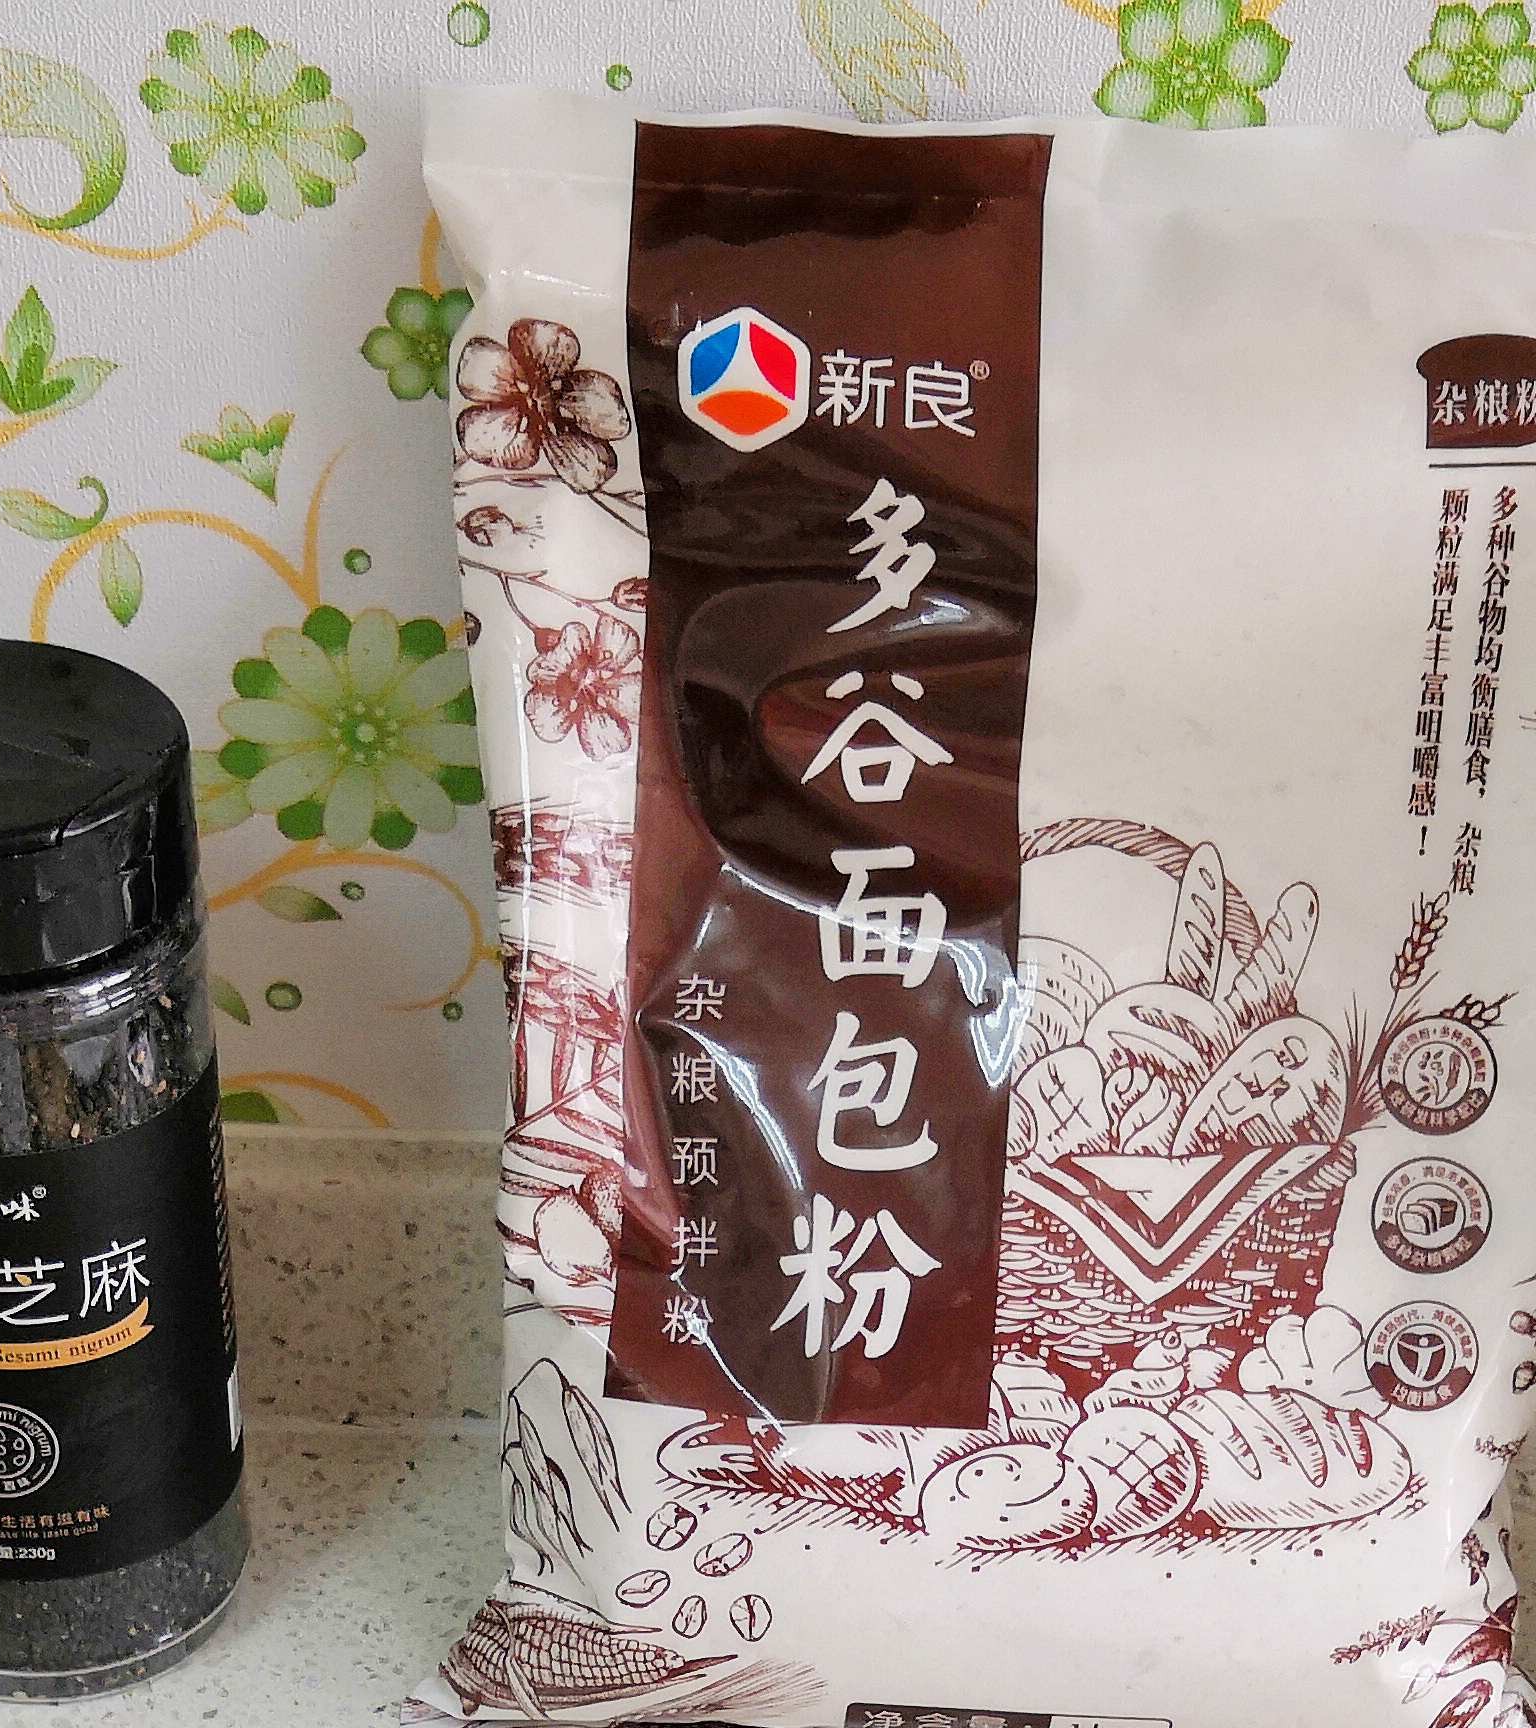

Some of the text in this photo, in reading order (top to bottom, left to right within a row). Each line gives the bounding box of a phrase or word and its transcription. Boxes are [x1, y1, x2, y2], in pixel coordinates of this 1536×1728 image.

[814, 348, 977, 438] 新良
[769, 476, 954, 1360] 多谷面包粉
[662, 973, 726, 1348] 杂粮预拌粉
[69, 1326, 133, 1358] nigrum
